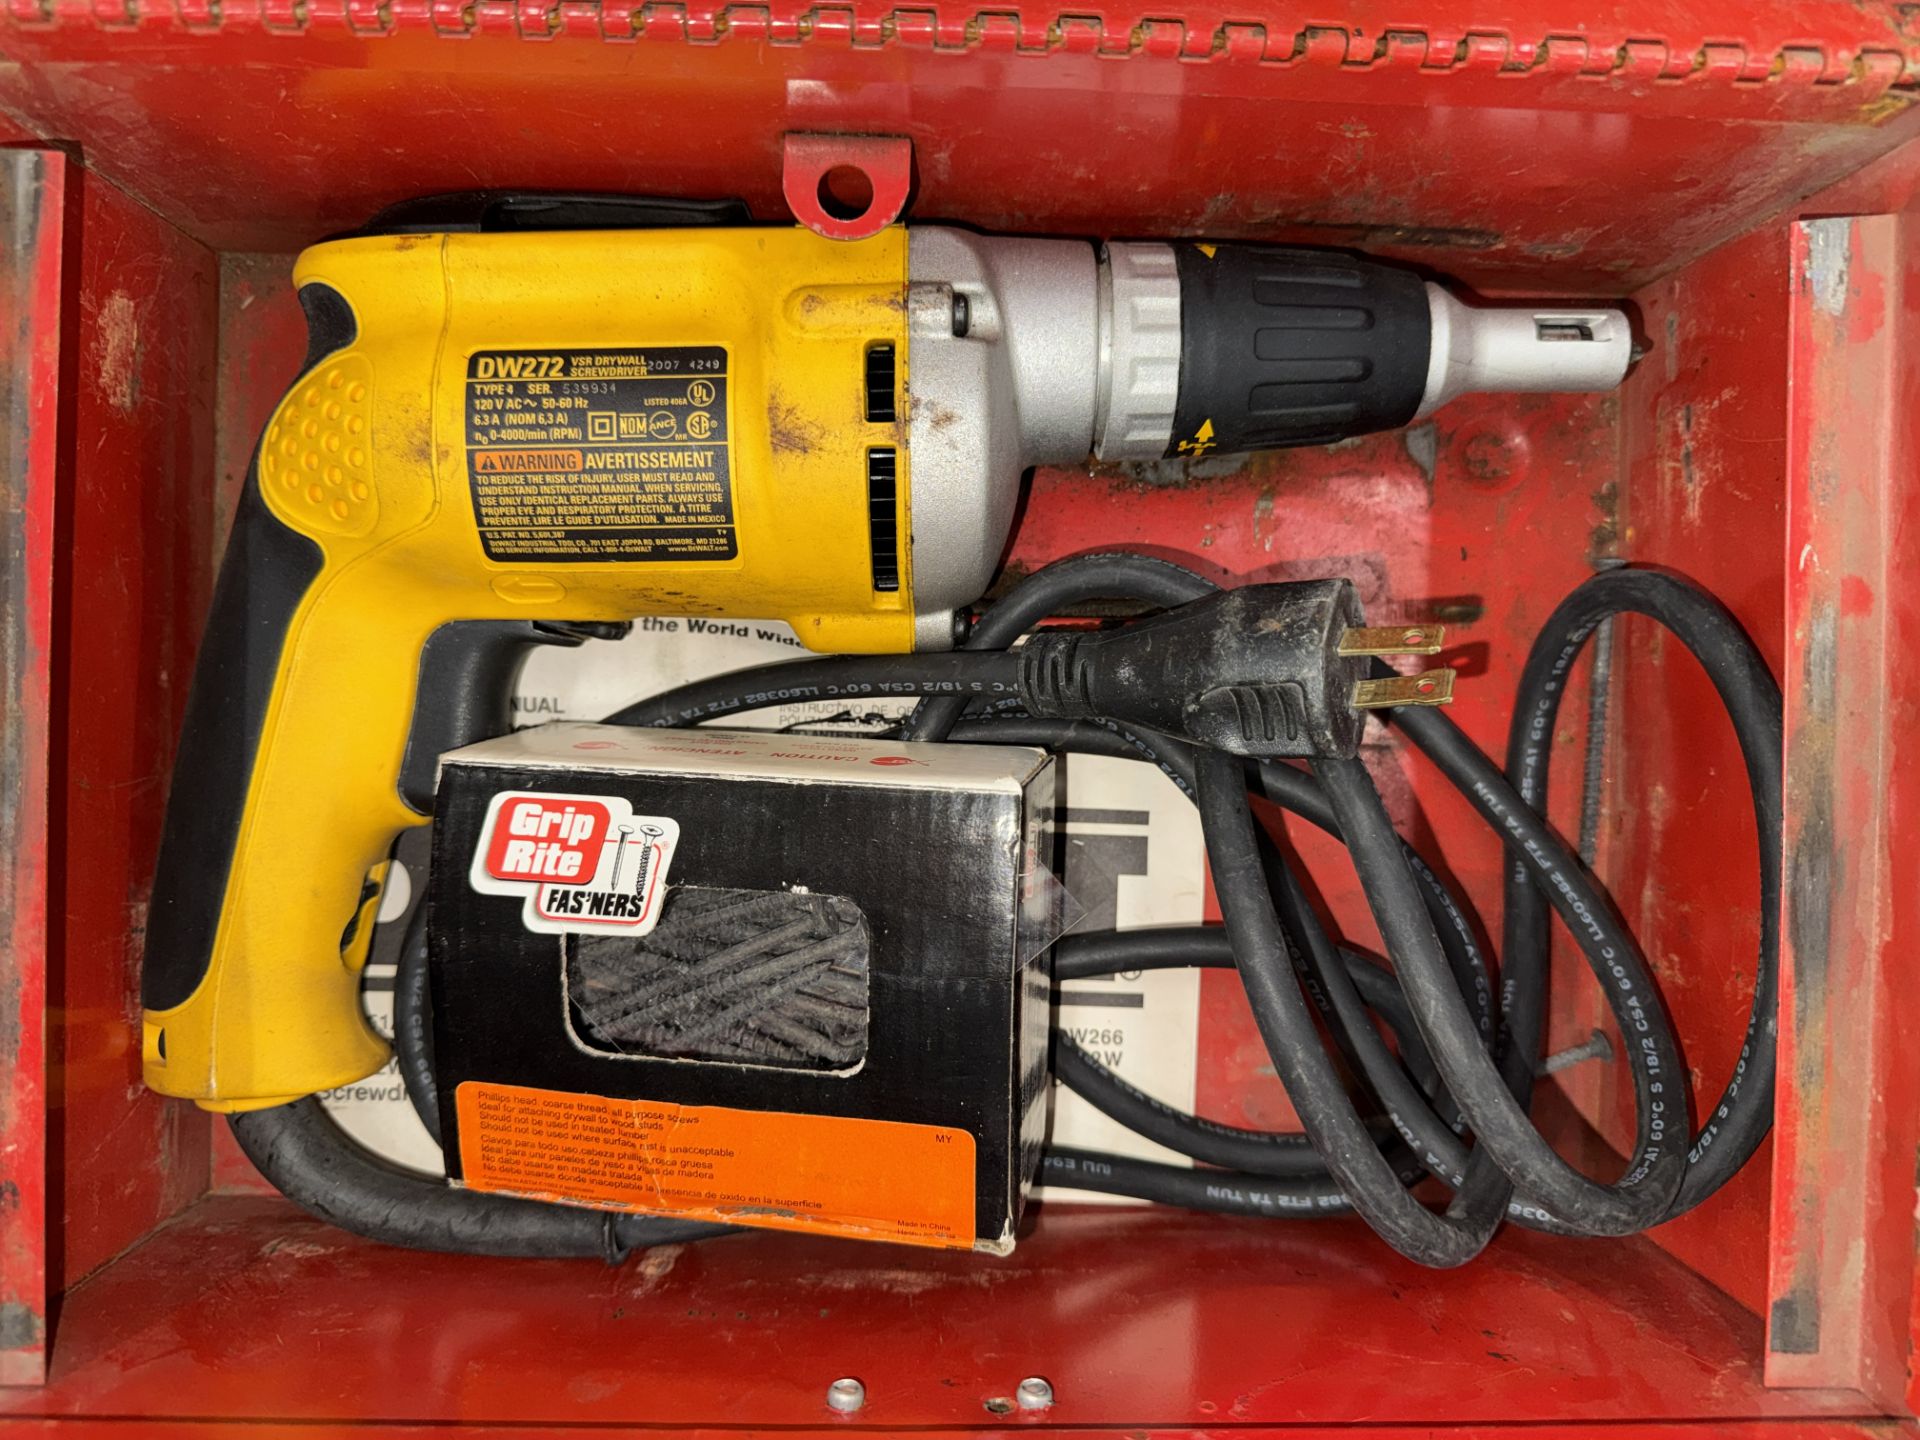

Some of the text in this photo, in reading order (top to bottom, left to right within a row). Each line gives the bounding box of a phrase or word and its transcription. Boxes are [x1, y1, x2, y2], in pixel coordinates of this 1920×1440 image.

[477, 356, 565, 379] DW272
[570, 355, 648, 366] VSR DRYWALL
[648, 359, 720, 371] 2007 4249
[570, 366, 648, 377] SCREWDRIVER
[475, 382, 616, 395] TYPE 4 SER. 539934
[475, 397, 589, 410] 120 V 50-60 Hz
[643, 398, 669, 406] LISTED
[474, 414, 490, 426] 6.3
[491, 414, 500, 426] A
[505, 413, 536, 426] (NOM
[556, 412, 568, 425] A)
[620, 416, 678, 435] NOM ANCE
[490, 427, 582, 441] 0-4000/min (RPM)
[499, 451, 714, 470] WARNING AVERTISSEMENT
[476, 471, 715, 485] TO REDUCE THE RISK OF USER MUST READ AND
[478, 484, 538, 495] UNDERSTAND
[540, 483, 599, 494] INSTRUCTION
[645, 483, 672, 493] WHEN
[480, 492, 723, 506] USE ONLY IDENTICAL REPLACEMENT ALWAYS USE
[481, 507, 517, 516] PROPER
[519, 506, 535, 516] EYE
[536, 506, 556, 515] AND
[557, 505, 616, 515] RESPIRATORY
[688, 503, 712, 513] TITRE
[532, 516, 553, 526] LIRE
[554, 516, 564, 525] LE
[566, 515, 593, 525] GUIDE
[665, 515, 687, 523] MADE
[688, 515, 697, 523] IN
[698, 515, 726, 523] MEXICO
[642, 617, 748, 638] the World
[745, 686, 820, 704] LL60382
[878, 682, 916, 692] CSA
[922, 682, 962, 691] 18/2
[708, 697, 740, 712] FT2
[508, 802, 596, 847] Grip
[501, 839, 584, 877] Rite
[1524, 839, 1552, 870] FT2
[546, 889, 645, 918] FAS'NERS
[1551, 871, 1605, 941] LL60382
[1627, 995, 1648, 1031] CSA
[1641, 1037, 1660, 1075] 18/2
[1650, 1082, 1663, 1093] S
[478, 1090, 700, 1124] Phillips coarse all purpose screws
[478, 1101, 664, 1131] Ideal for attaching drywall to wood studs
[479, 1111, 649, 1140] Should not be used in treated lumber
[480, 1121, 512, 1132] Should
[514, 1125, 530, 1134] not
[532, 1128, 544, 1136] be
[546, 1129, 569, 1139] used
[571, 1133, 600, 1143] where
[603, 1136, 637, 1149] surface
[659, 1144, 667, 1153] is
[669, 1144, 735, 1157] unacceptable
[935, 1133, 953, 1144] MY
[1688, 1125, 1717, 1164] 18/2
[480, 1134, 713, 1170] Clavos para todo gruesa
[481, 1143, 715, 1179] Ideal para unir paneles de yeso a de madera
[482, 1154, 496, 1163] No
[524, 1159, 555, 1169] usarse
[571, 1166, 607, 1177] madera
[609, 1170, 643, 1181] tratada
[483, 1163, 497, 1172] No
[498, 1165, 521, 1174] debe
[524, 1169, 555, 1179] usarse
[558, 1171, 587, 1183] donde
[590, 1178, 643, 1192] inaceptable
[647, 1183, 655, 1193] la
[704, 1190, 717, 1200] de
[748, 1195, 761, 1204] en
[763, 1195, 772, 1205] la
[775, 1197, 823, 1210] superficie
